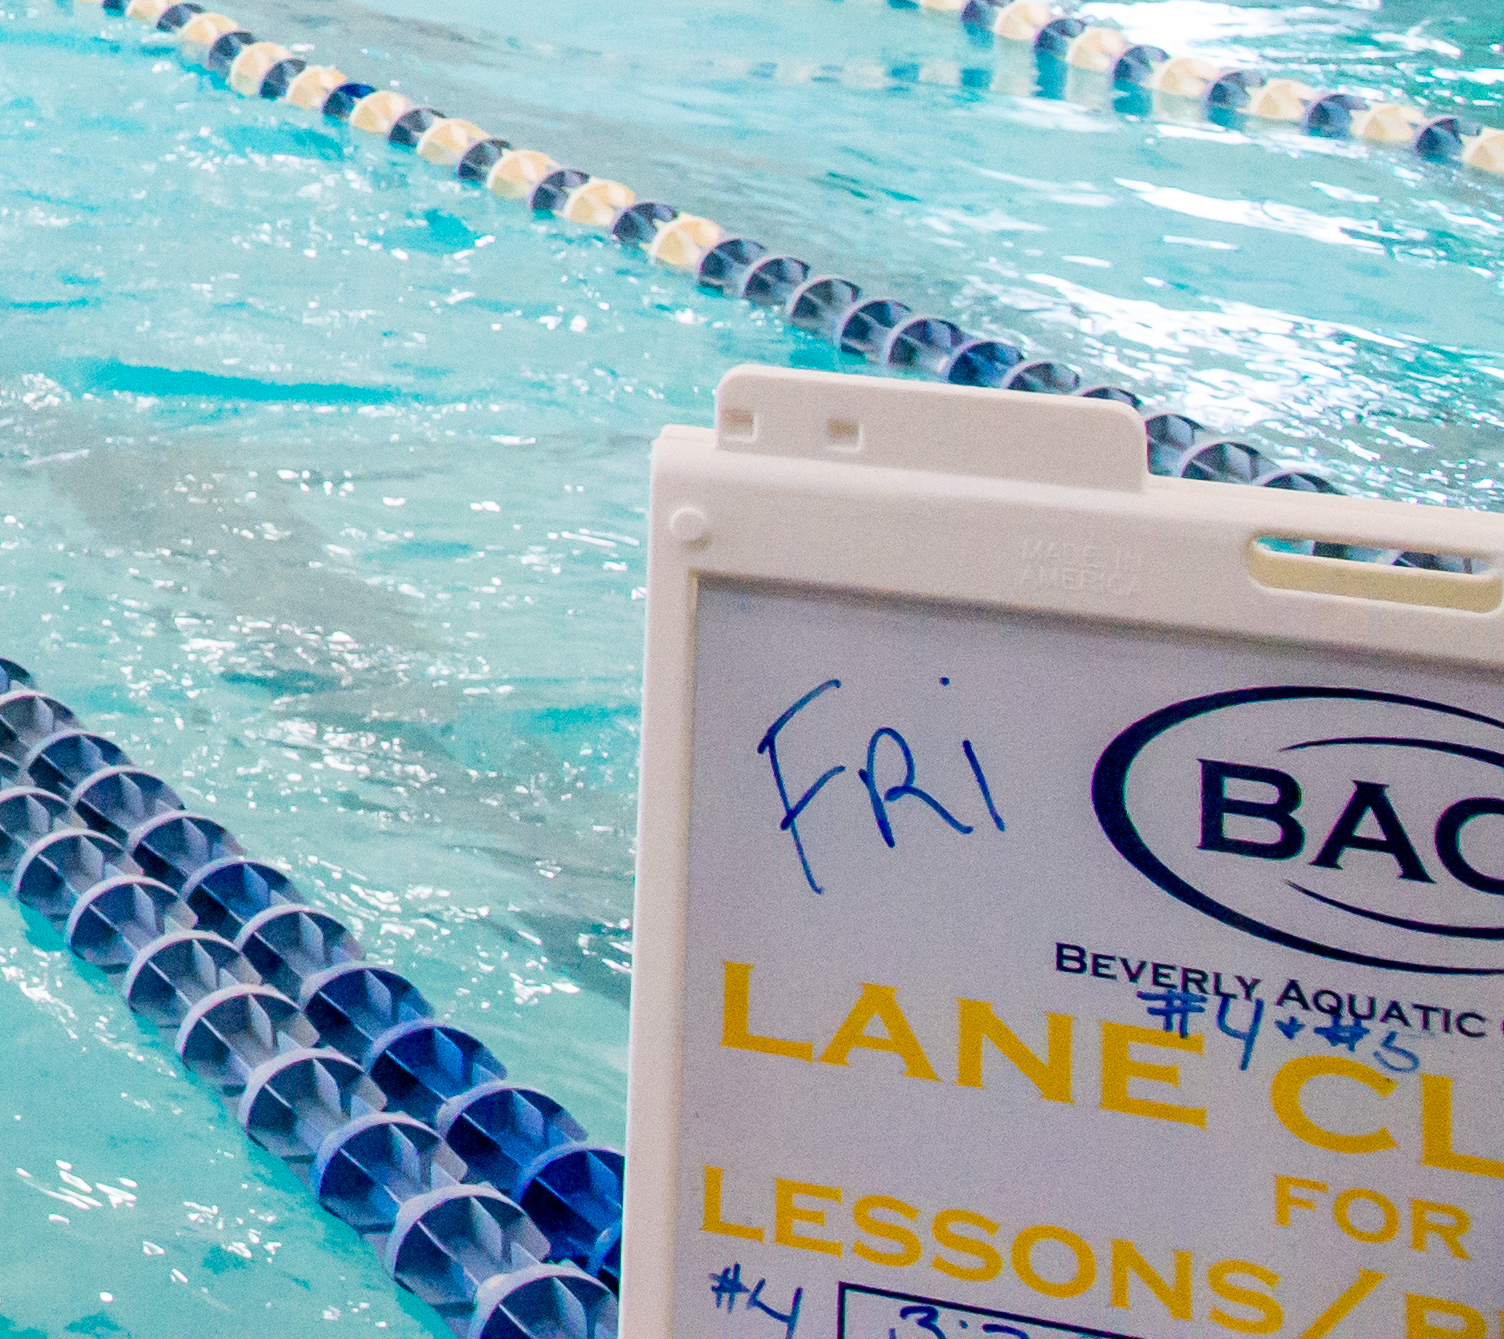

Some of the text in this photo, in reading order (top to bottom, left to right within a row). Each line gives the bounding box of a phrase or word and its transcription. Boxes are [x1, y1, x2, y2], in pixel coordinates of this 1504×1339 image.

[1195, 758, 1504, 896] BAC
[719, 961, 1209, 1131] LANE
[1055, 942, 1488, 1039] BEVERLY AQUATIC
[1274, 1173, 1473, 1261] FOR
